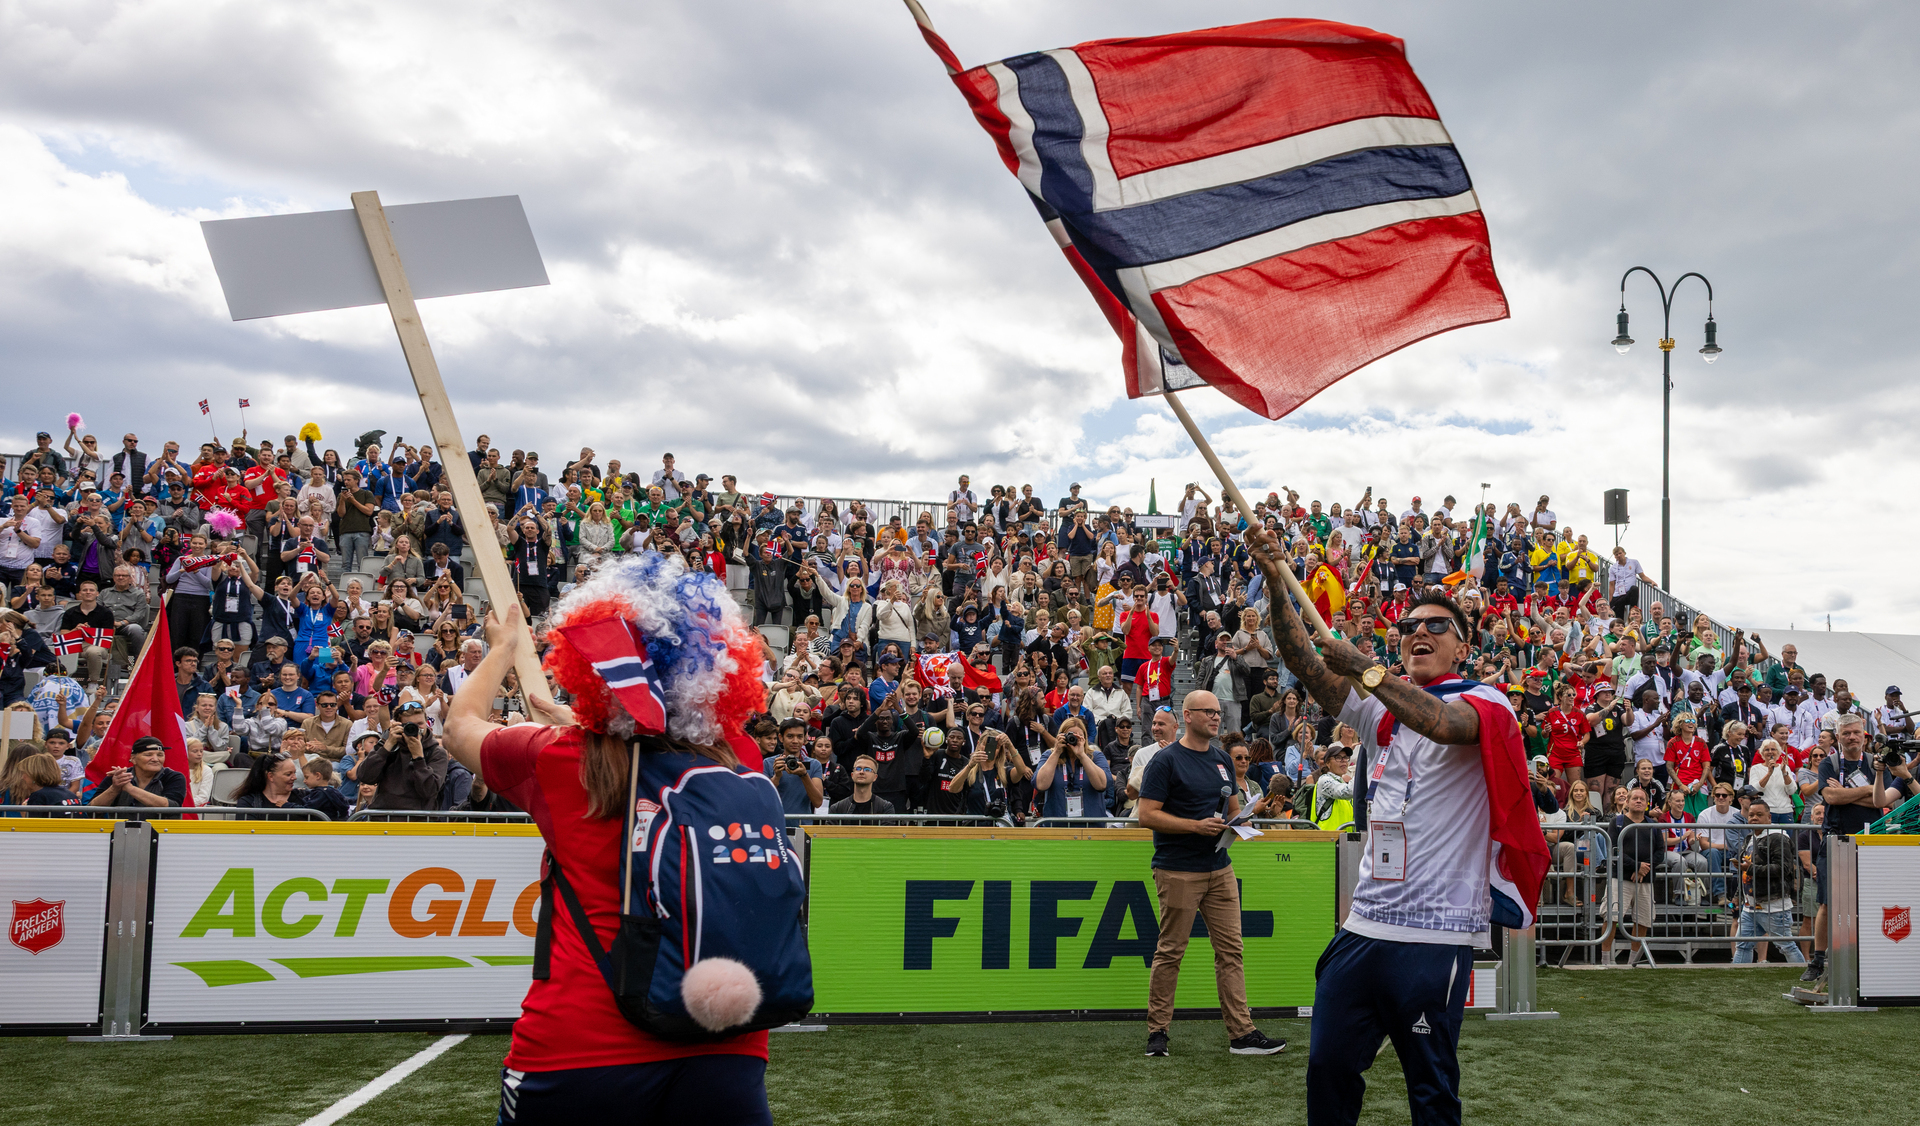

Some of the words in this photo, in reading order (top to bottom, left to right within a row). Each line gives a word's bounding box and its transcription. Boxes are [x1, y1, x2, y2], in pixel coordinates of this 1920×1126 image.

[1562, 723, 1569, 734] 3
[940, 758, 947, 770] 1
[1685, 756, 1692, 768] 7
[708, 822, 775, 841] OSLO
[774, 826, 789, 864] NORWAY
[712, 844, 781, 870] 2025
[18, 917, 59, 944] ARMEEN
[1411, 1026, 1431, 1035] SELECT
